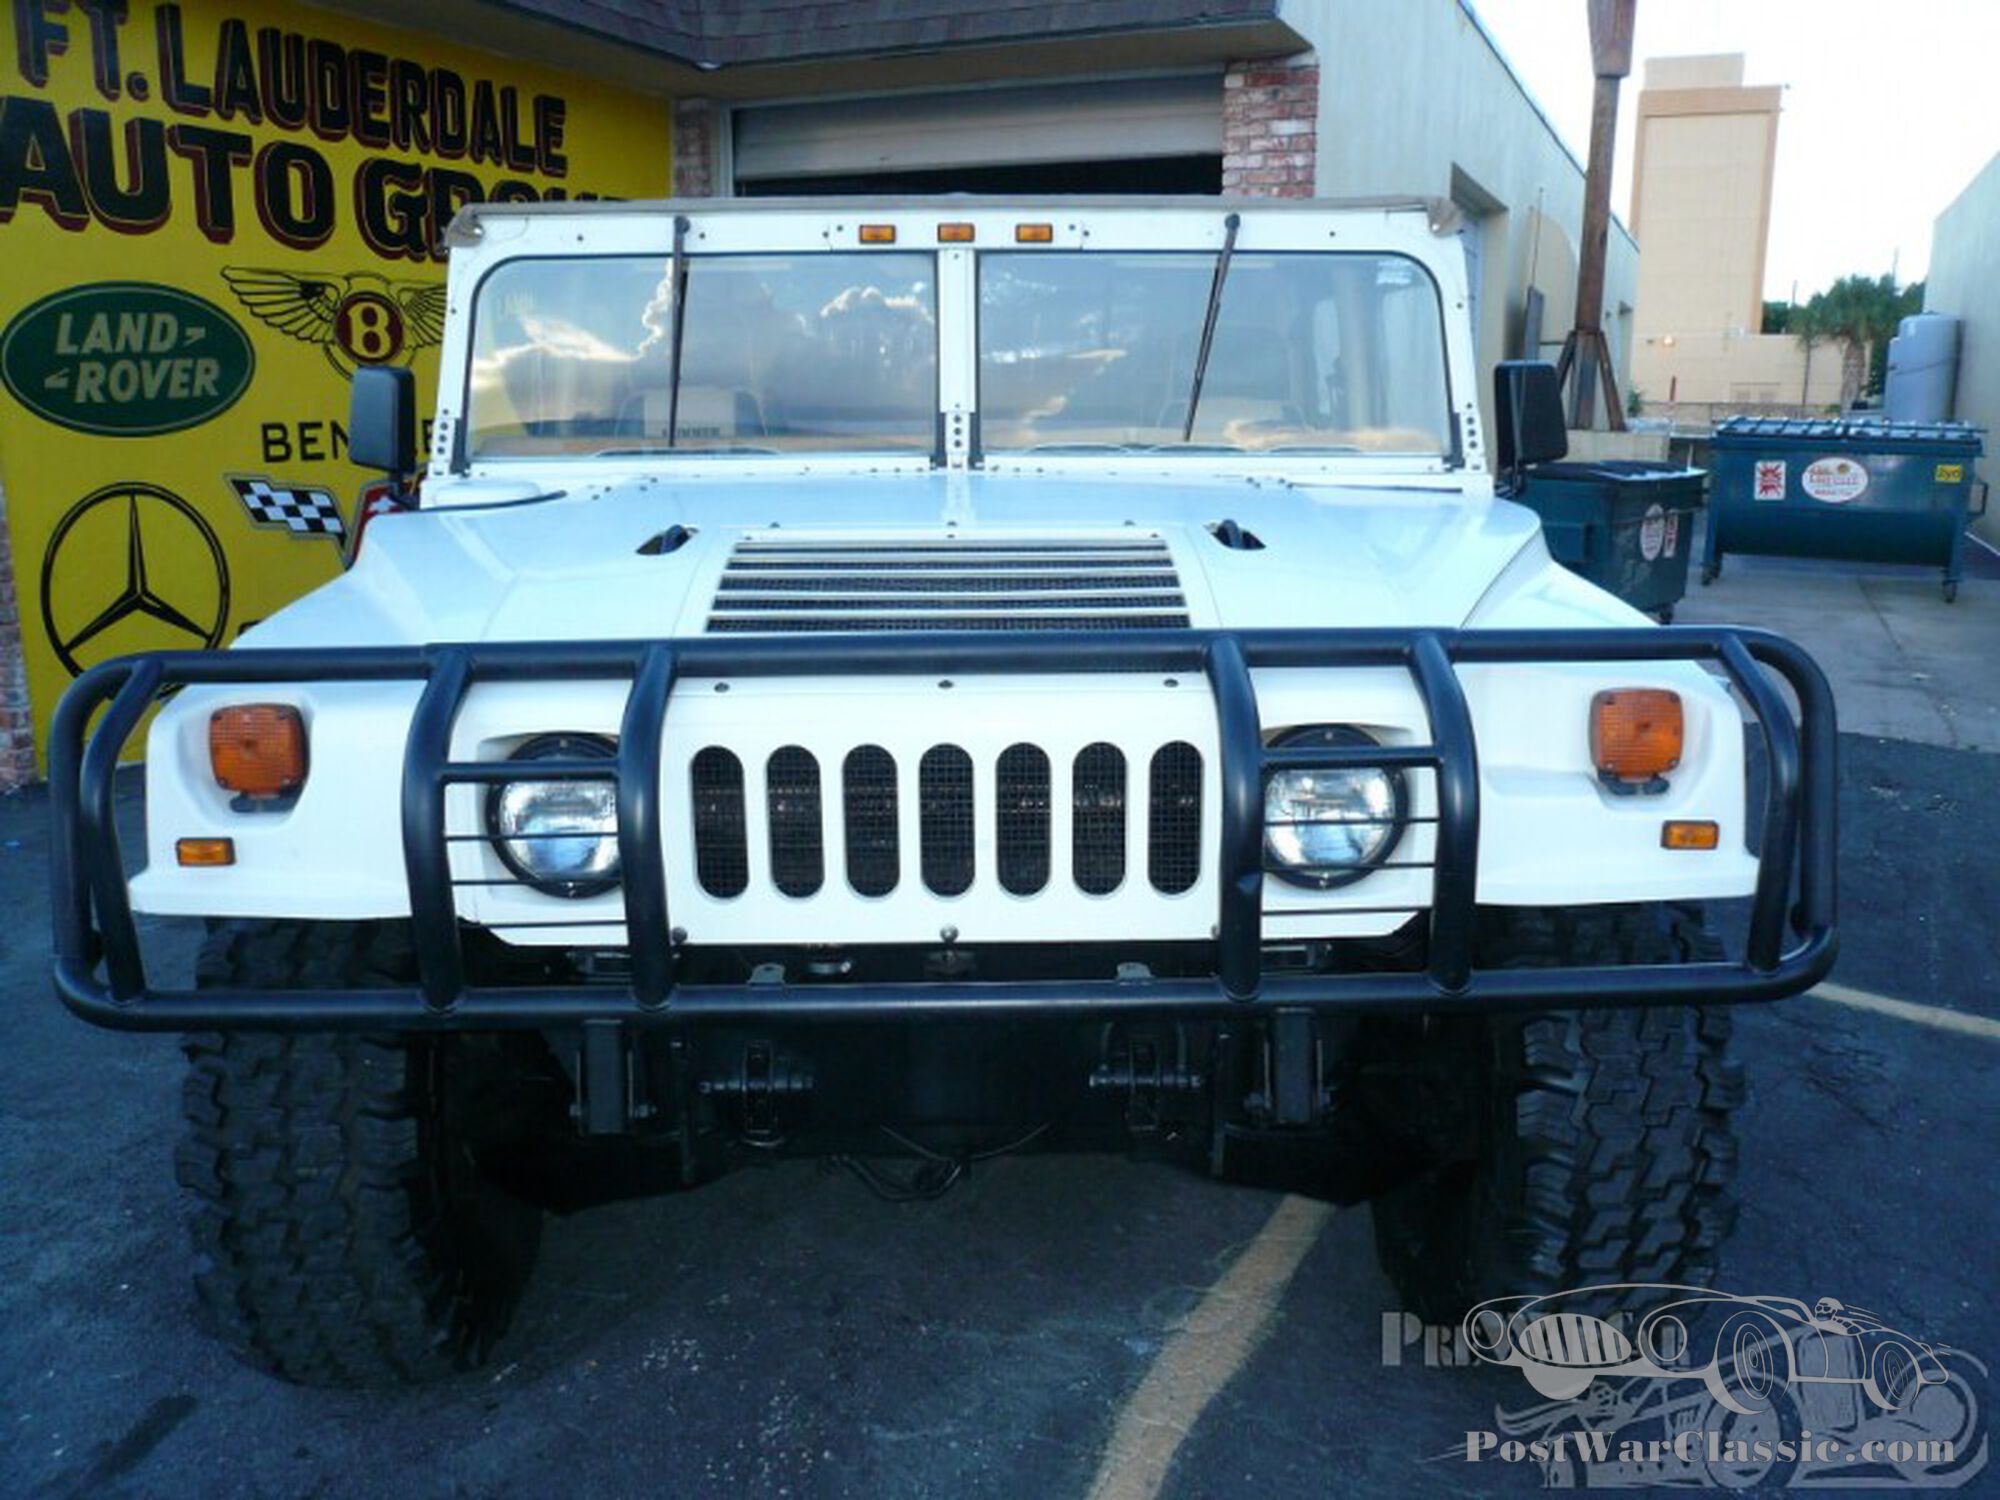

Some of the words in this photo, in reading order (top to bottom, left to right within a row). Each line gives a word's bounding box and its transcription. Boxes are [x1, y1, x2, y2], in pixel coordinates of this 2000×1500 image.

[0, 95, 335, 252] AUTO
[56, 312, 179, 355] LAND
[75, 357, 221, 403] ROVER
